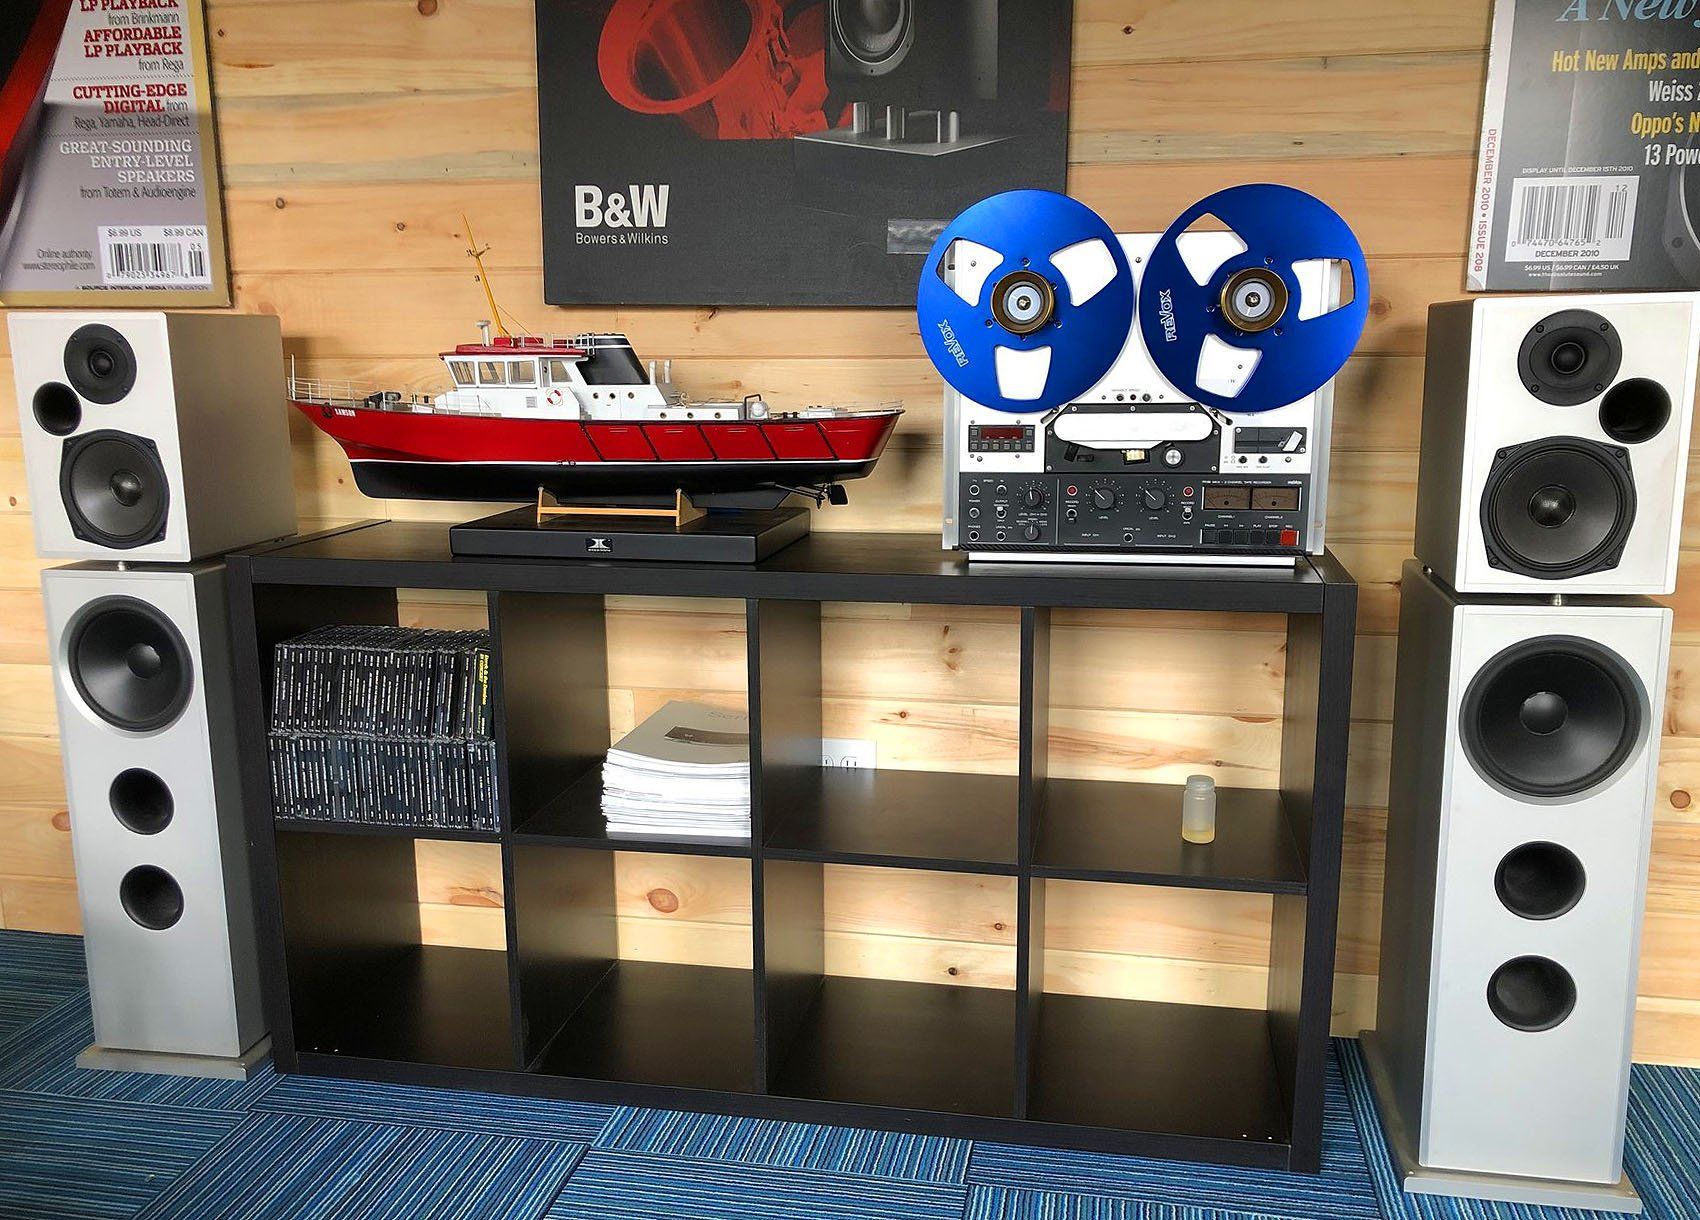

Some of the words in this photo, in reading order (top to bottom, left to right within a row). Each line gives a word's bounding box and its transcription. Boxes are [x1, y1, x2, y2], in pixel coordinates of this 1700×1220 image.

[81, 0, 98, 11] LP
[101, 0, 179, 10] PLAYBACK
[1555, 0, 1590, 22] A
[1598, 0, 1698, 21] New
[108, 13, 129, 25] from
[131, 10, 180, 24] Brinkmann
[84, 26, 182, 42] AFFORDABLE
[84, 45, 102, 57] LP
[105, 42, 183, 56] PLAYBACK
[138, 60, 159, 71] from
[162, 58, 184, 73] Rega
[1552, 50, 1579, 72] Hot
[1585, 49, 1619, 71] New
[1622, 48, 1667, 74] Amps
[1670, 47, 1700, 70] and
[73, 84, 187, 99] CUTTING-EDGE
[1649, 79, 1694, 102] Weiss
[104, 100, 165, 114] DIGITAL
[166, 99, 189, 111] from
[138, 113, 190, 127] Head-Direct
[1631, 111, 1685, 139] Oppo's
[60, 140, 192, 154] GREAT-SOUNDING
[1644, 143, 1662, 166] 13
[90, 154, 194, 168] ENTRY-LEVEL
[1484, 128, 1497, 184] DECEMBER
[117, 170, 195, 183] SPEAKERS
[80, 186, 101, 198] from
[102, 186, 131, 198] Totem
[133, 187, 140, 198] &
[141, 186, 196, 200] Audioengine
[1480, 187, 1491, 211] 2010
[574, 184, 670, 228] B&W
[130, 228, 142, 237] US
[185, 228, 204, 237] CAN
[575, 232, 618, 244] Bowers
[619, 234, 626, 244] &
[627, 232, 669, 244] Wilkins
[1476, 220, 1487, 250] ISSUE
[37, 248, 60, 258] Online
[1535, 249, 1579, 257] DECEMBER
[1580, 249, 1600, 257] 2010
[1474, 252, 1484, 272] 208
